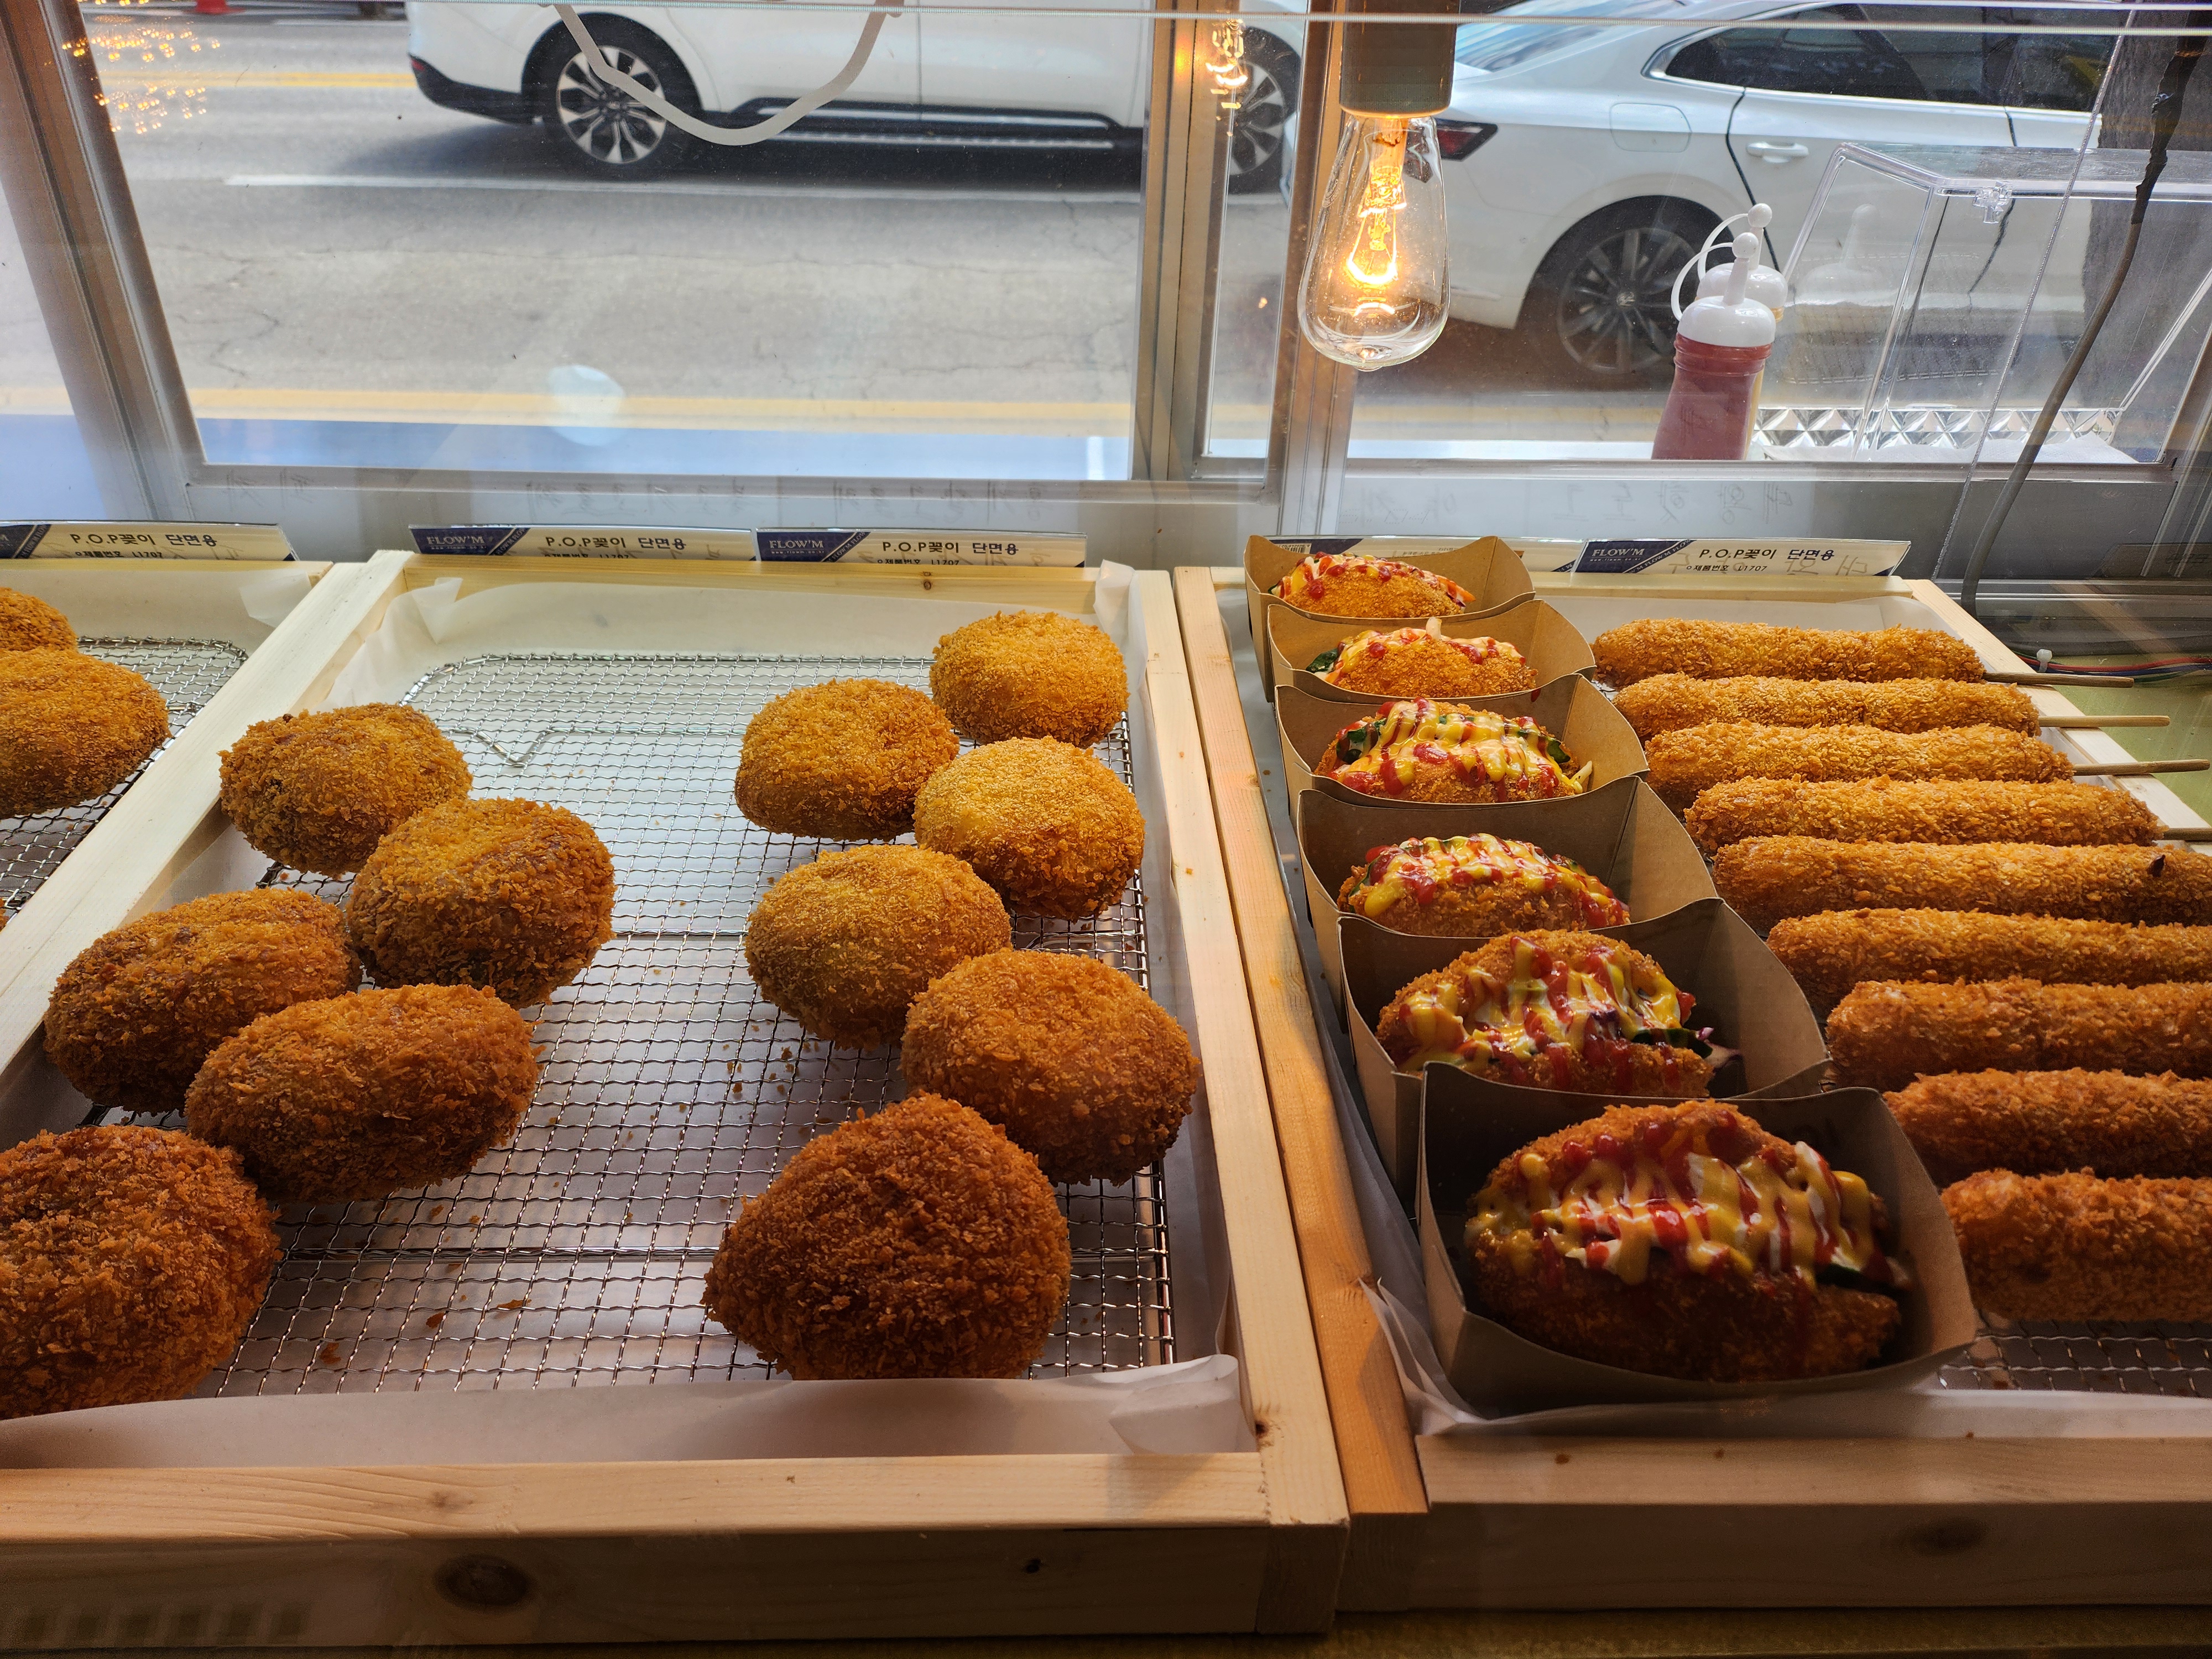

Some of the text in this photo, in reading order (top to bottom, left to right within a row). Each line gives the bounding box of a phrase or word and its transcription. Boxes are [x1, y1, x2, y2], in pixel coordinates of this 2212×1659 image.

[165, 534, 217, 547] 단면용
[427, 536, 485, 545] FLOW'M
[638, 538, 686, 550] 단면용
[769, 540, 824, 549] FLOW'M
[972, 542, 1019, 555] 단면용
[1592, 548, 1645, 556] FLOW'M
[1787, 549, 1835, 561] 단면용
